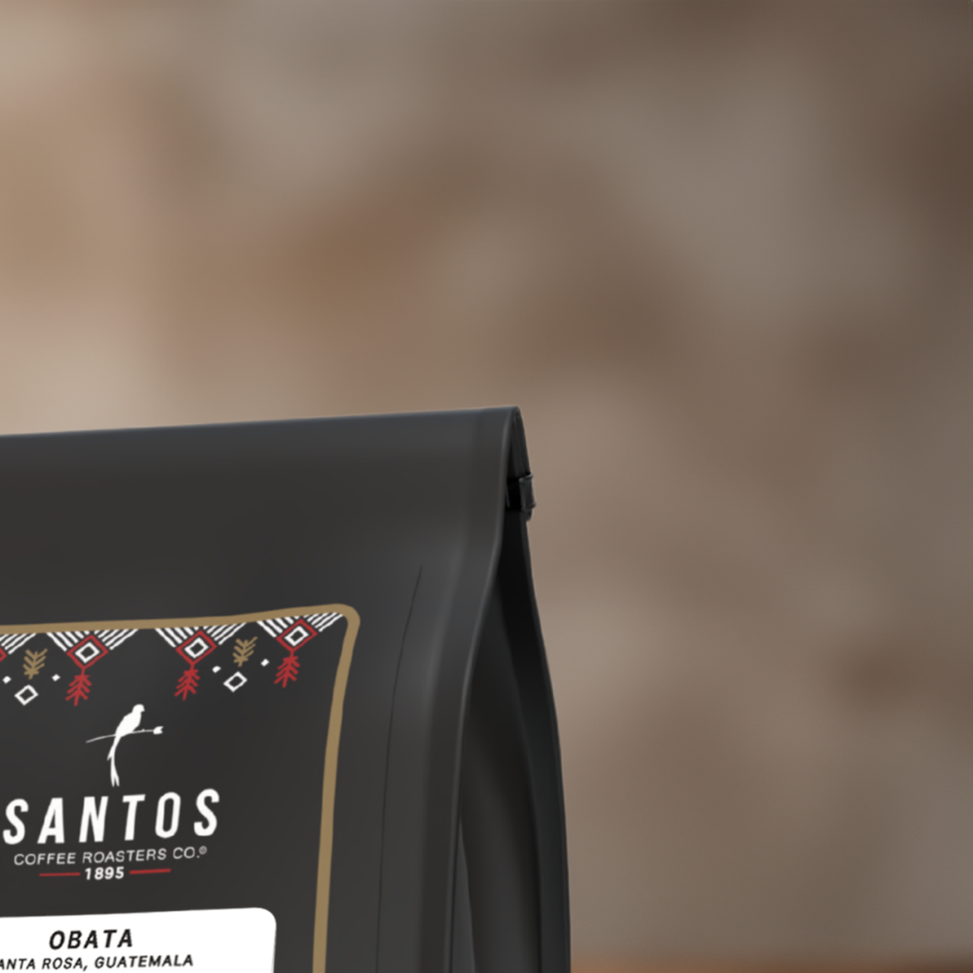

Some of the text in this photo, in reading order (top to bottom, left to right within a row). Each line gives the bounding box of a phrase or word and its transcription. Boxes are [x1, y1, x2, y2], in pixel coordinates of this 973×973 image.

[3, 788, 219, 845] SANTOS
[14, 852, 76, 865] COFFEE
[82, 848, 166, 863] ROASTERS
[85, 866, 124, 880] 1895
[49, 929, 132, 950] OBATA
[42, 957, 87, 971] ROSA,
[94, 954, 193, 969] GUATEMALA
